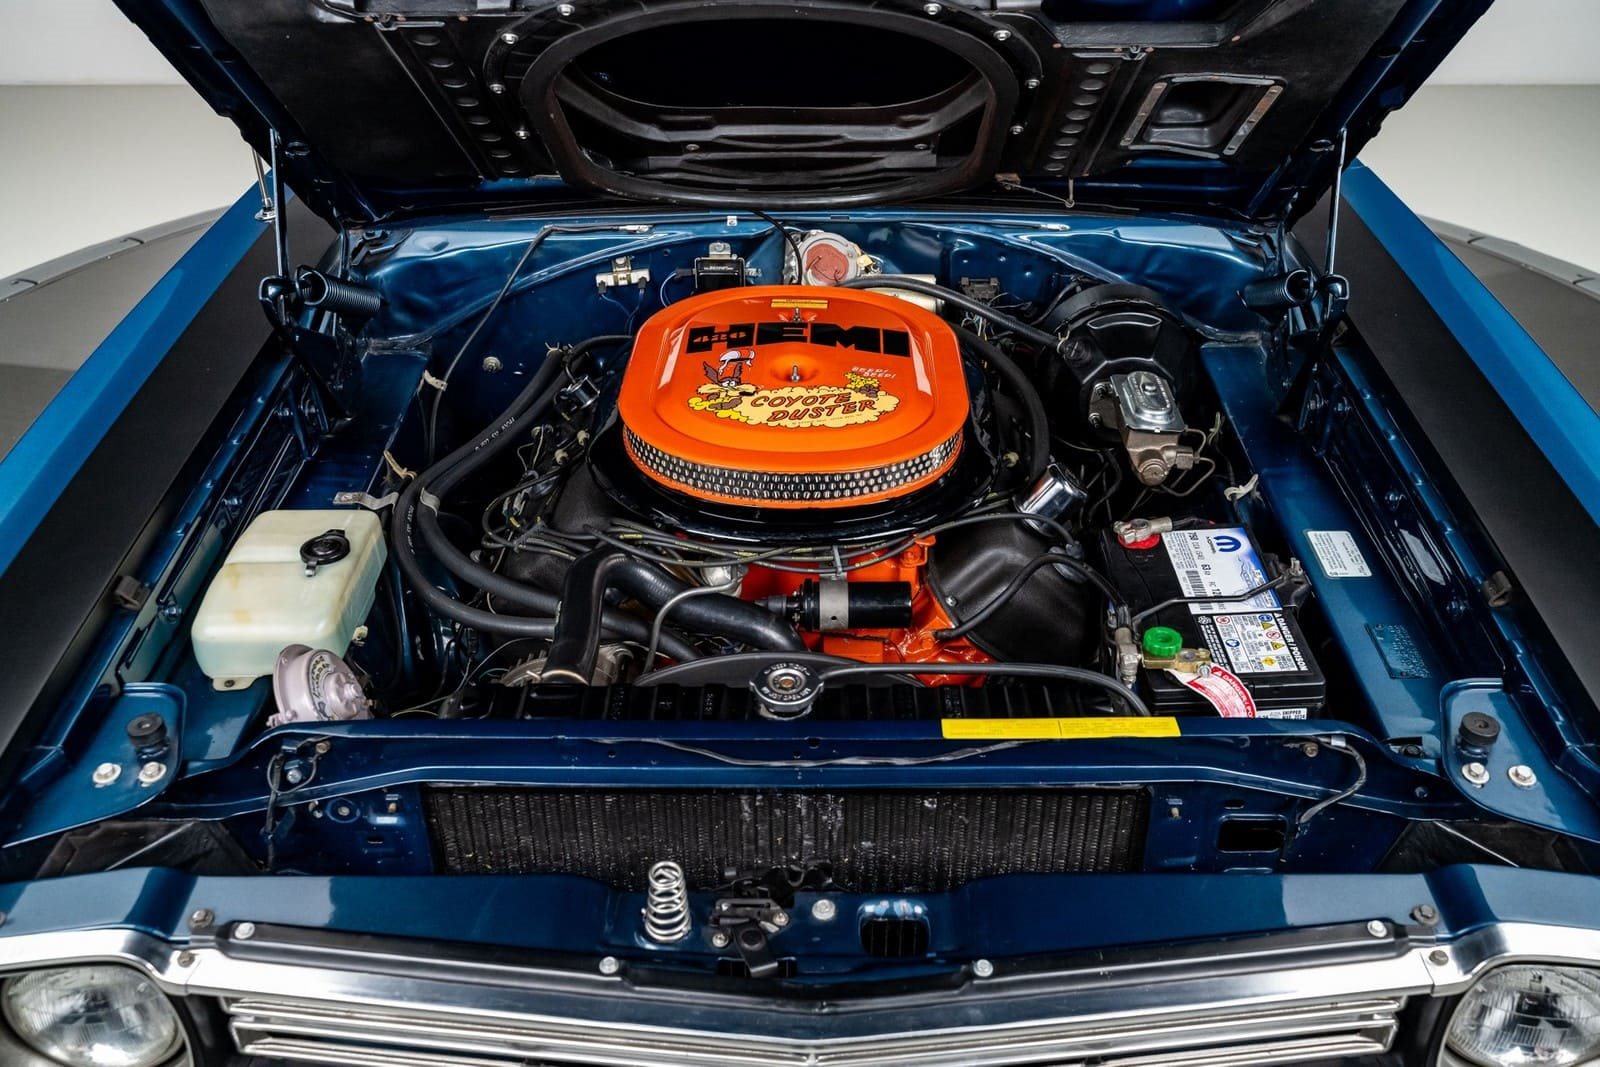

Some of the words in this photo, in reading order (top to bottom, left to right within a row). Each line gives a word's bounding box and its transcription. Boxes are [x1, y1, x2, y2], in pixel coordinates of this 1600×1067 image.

[686, 322, 911, 357] HEMI
[750, 392, 852, 408] COYOTE
[767, 399, 877, 422] DUSTER
[1277, 617, 1295, 643] DANGER
[1290, 646, 1309, 671] POISON
